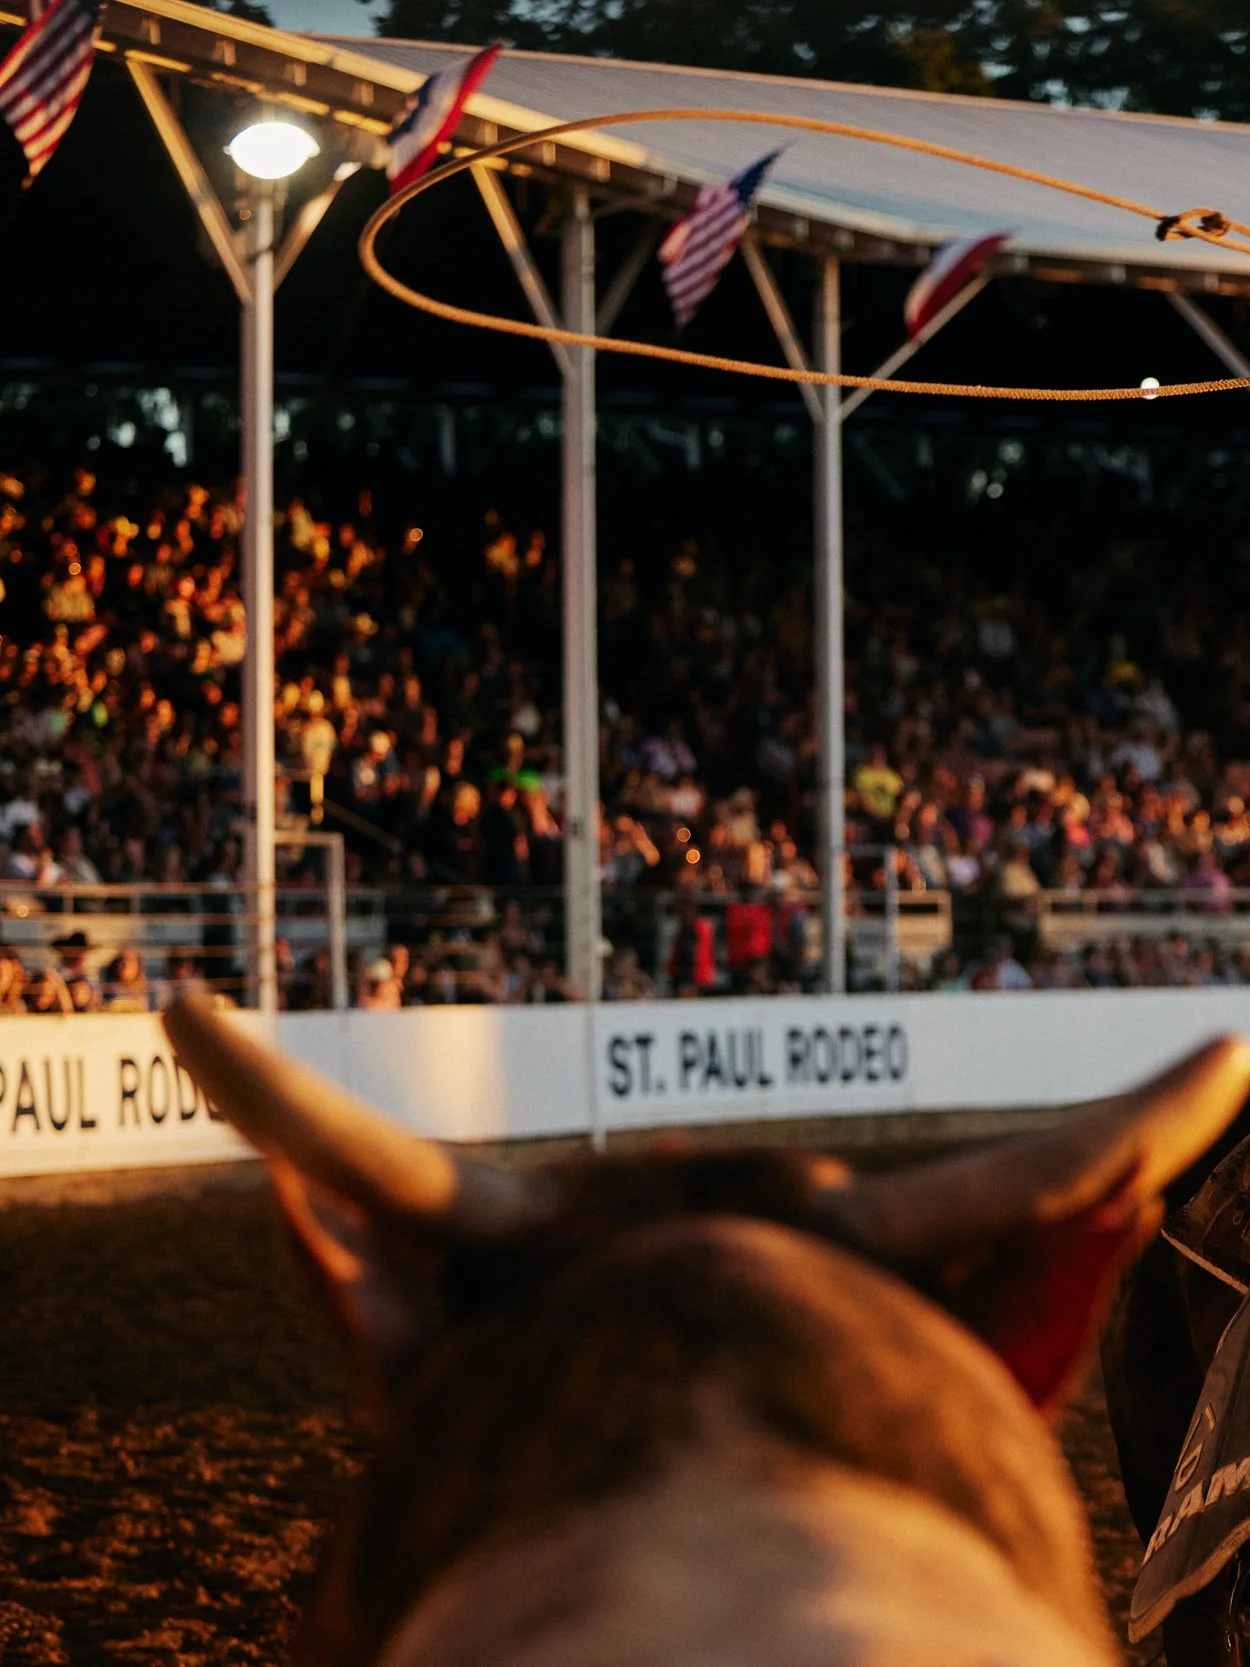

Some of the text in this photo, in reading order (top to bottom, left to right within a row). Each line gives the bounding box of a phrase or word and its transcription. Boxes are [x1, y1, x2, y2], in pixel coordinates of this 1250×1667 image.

[0, 1055, 226, 1132] AUL ROD
[608, 1023, 908, 1098] ST. PAUL RODEO
